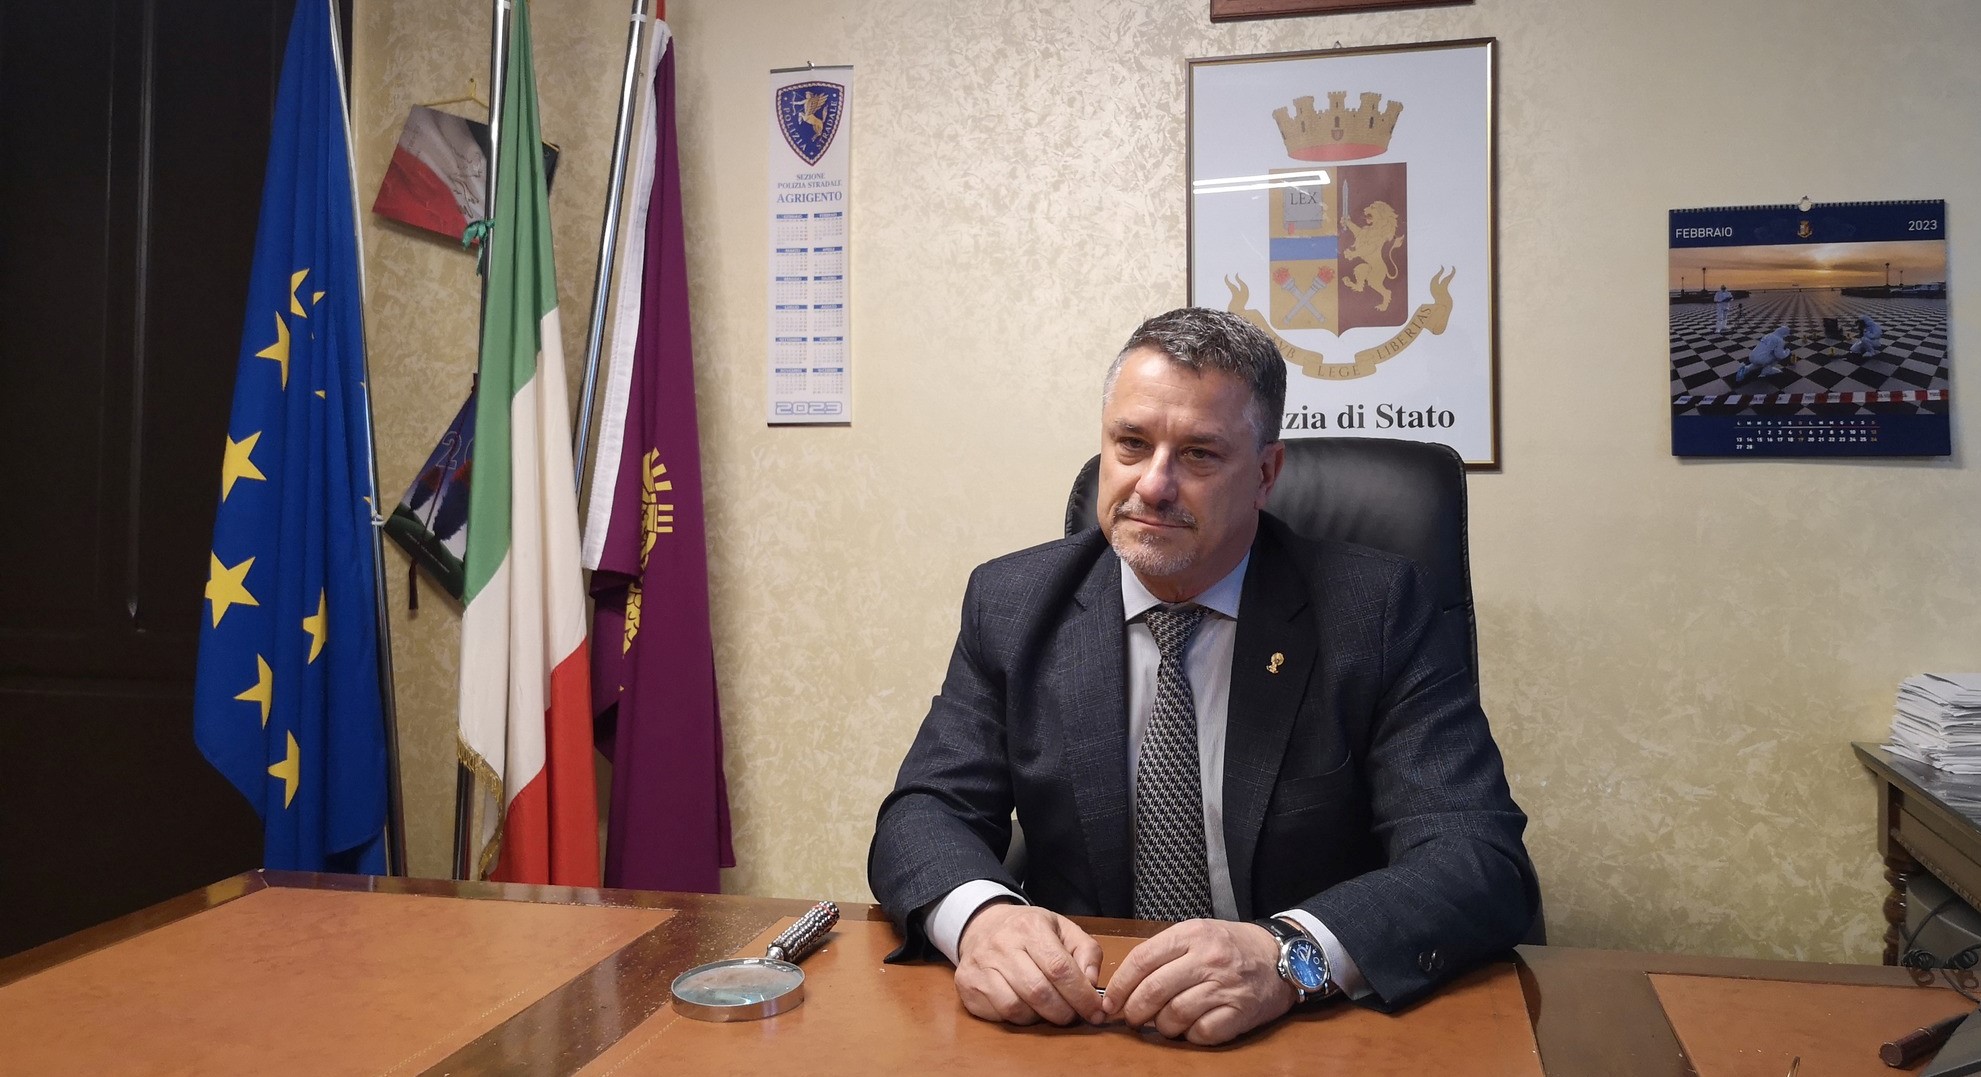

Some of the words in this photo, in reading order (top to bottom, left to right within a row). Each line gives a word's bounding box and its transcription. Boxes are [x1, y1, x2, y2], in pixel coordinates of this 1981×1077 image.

[784, 108, 806, 150] POLIZIA
[816, 100, 838, 150] STRADALE
[808, 180, 842, 188] STRADALE
[776, 190, 842, 203] AGRIGENTO
[1290, 192, 1317, 205] LEX
[1908, 220, 1938, 230] 2023
[1675, 226, 1733, 239] FEBBRAIO
[1318, 365, 1361, 378] LEGE
[1376, 306, 1432, 360] LIBERTAS
[776, 402, 842, 415] 2023
[1336, 404, 1366, 430] di
[1375, 402, 1456, 430] Stato
